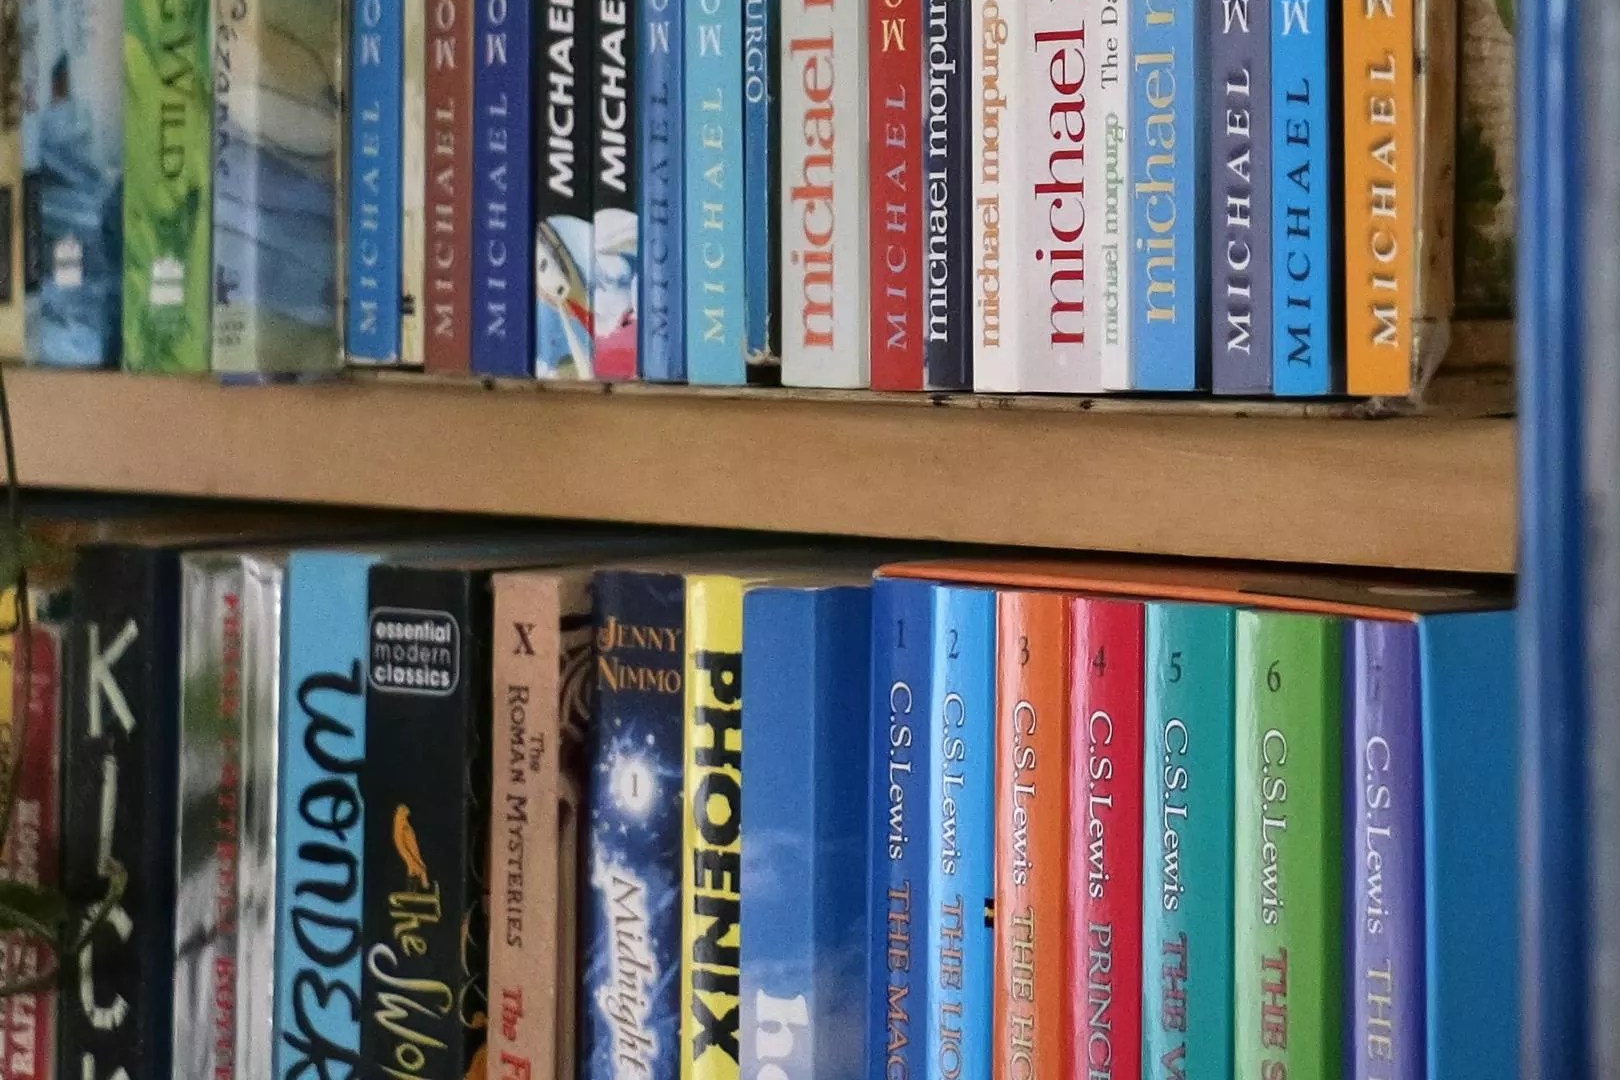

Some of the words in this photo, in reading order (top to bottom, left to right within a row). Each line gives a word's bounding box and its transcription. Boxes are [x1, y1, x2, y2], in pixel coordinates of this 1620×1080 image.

[159, 33, 195, 180] WILD
[981, 0, 1009, 186] morpurgo
[1100, 37, 1120, 90] The
[359, 100, 381, 335] MICHAEL
[433, 95, 456, 338] MICHAEL
[486, 92, 509, 337] MICHAEL
[649, 81, 670, 341] MICHAEL
[702, 87, 726, 344] MICHAEL
[789, 29, 836, 352] michael
[885, 84, 908, 352] MICHAEL
[1034, 19, 1086, 350] michael
[1103, 111, 1128, 236] morpurgo
[1135, 46, 1178, 325] michael
[1225, 67, 1252, 356] MICHAEL
[1286, 76, 1312, 368] MICHAEL
[1369, 53, 1400, 350] MICHAEL
[976, 193, 1000, 349] michael
[1100, 242, 1120, 347] michael
[374, 642, 451, 665] modern
[374, 663, 450, 687] classics
[375, 620, 451, 643] essential
[513, 622, 536, 657] X
[598, 655, 682, 694] NIMMO
[600, 614, 682, 653] JENNY
[895, 620, 906, 650] 1
[948, 628, 961, 660] 2
[1017, 635, 1031, 669] 3
[1092, 644, 1107, 678] 4
[1168, 651, 1183, 684] 5
[1265, 659, 1281, 694] 6
[507, 683, 530, 784] ROMAN
[78, 618, 139, 1080] KIC
[505, 794, 528, 949] MYSTERIES
[691, 651, 743, 1067] PHOENIX
[388, 879, 442, 958] The
[887, 878, 911, 974] THE
[938, 894, 964, 991] THE
[1010, 905, 1035, 1003] THE
[502, 985, 524, 1041] The
[605, 874, 655, 1073] Midnight
[1162, 931, 1188, 1033] THE
[1260, 945, 1289, 1050] THE
[1365, 958, 1394, 1062] THE
